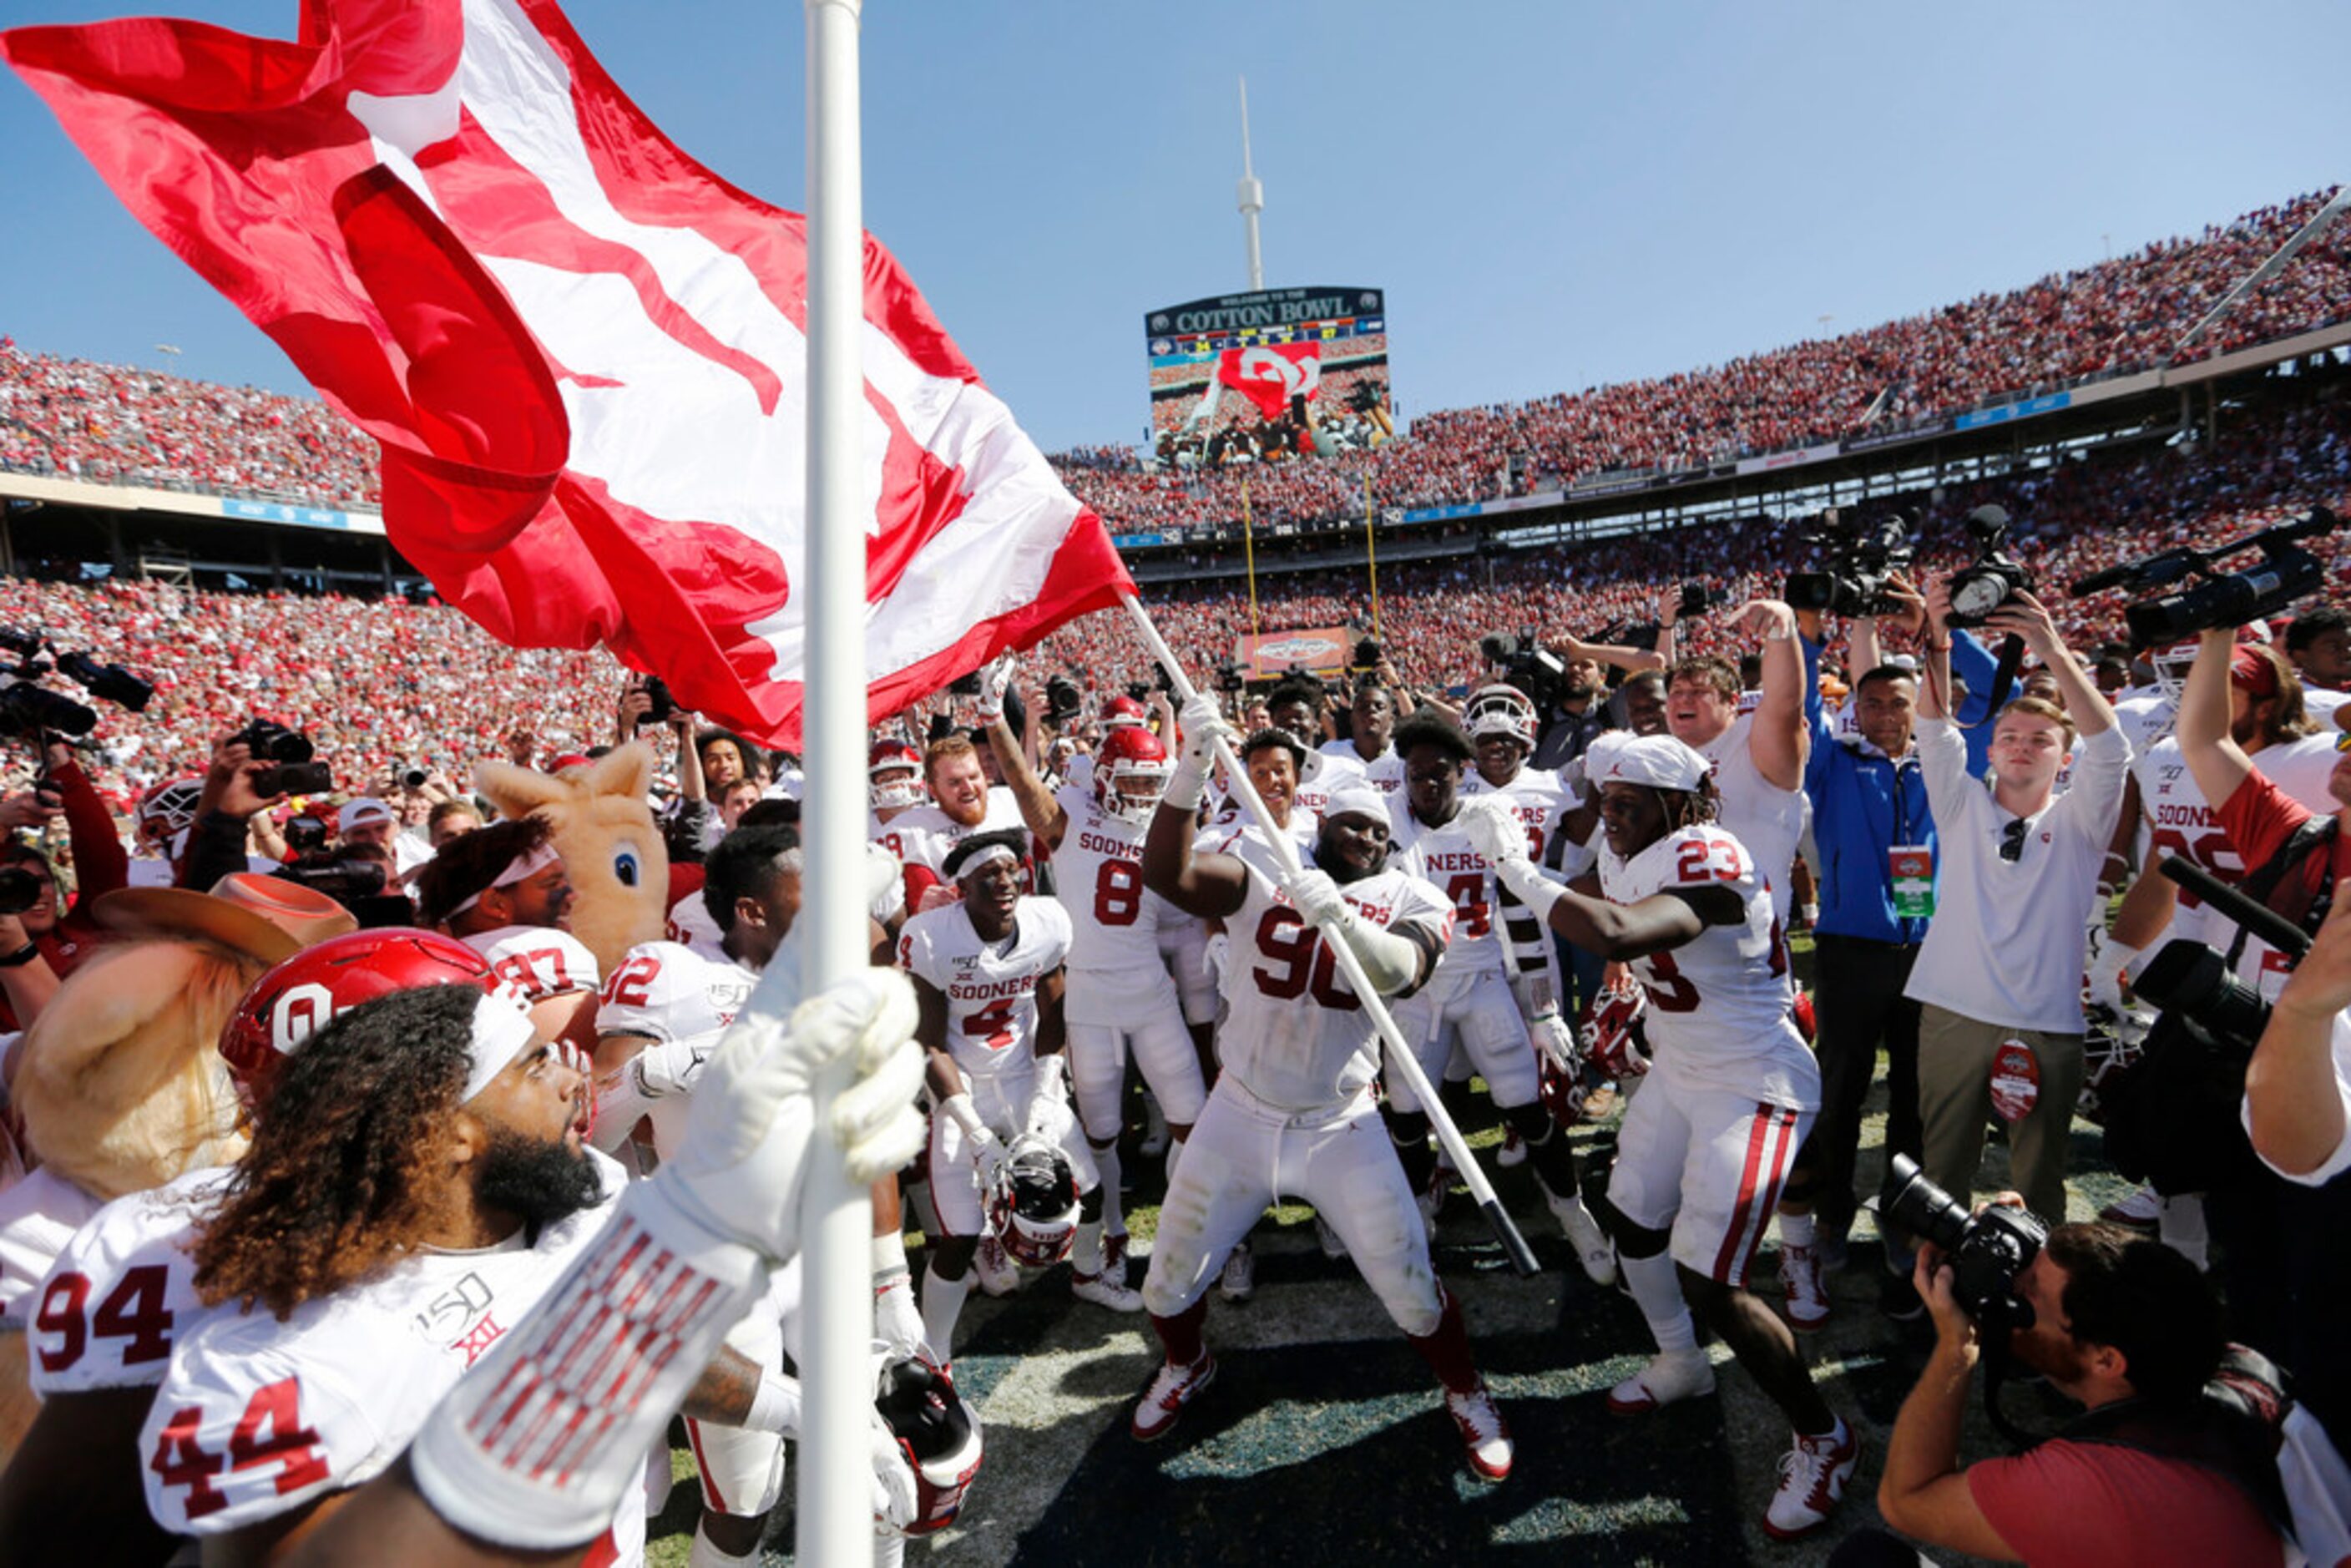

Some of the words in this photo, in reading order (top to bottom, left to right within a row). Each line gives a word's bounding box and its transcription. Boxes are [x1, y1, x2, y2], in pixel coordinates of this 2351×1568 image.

[1176, 306, 1274, 333] COTTON
[1280, 297, 1352, 322] BOWL
[1079, 832, 1145, 862] SOONE
[1428, 852, 1487, 872] NERS
[1676, 840, 1741, 883] 23
[1095, 858, 1144, 926] 8
[1447, 873, 1491, 939] 4
[963, 999, 1016, 1051] 4
[37, 1264, 174, 1373] 94
[150, 1374, 331, 1520] 44
